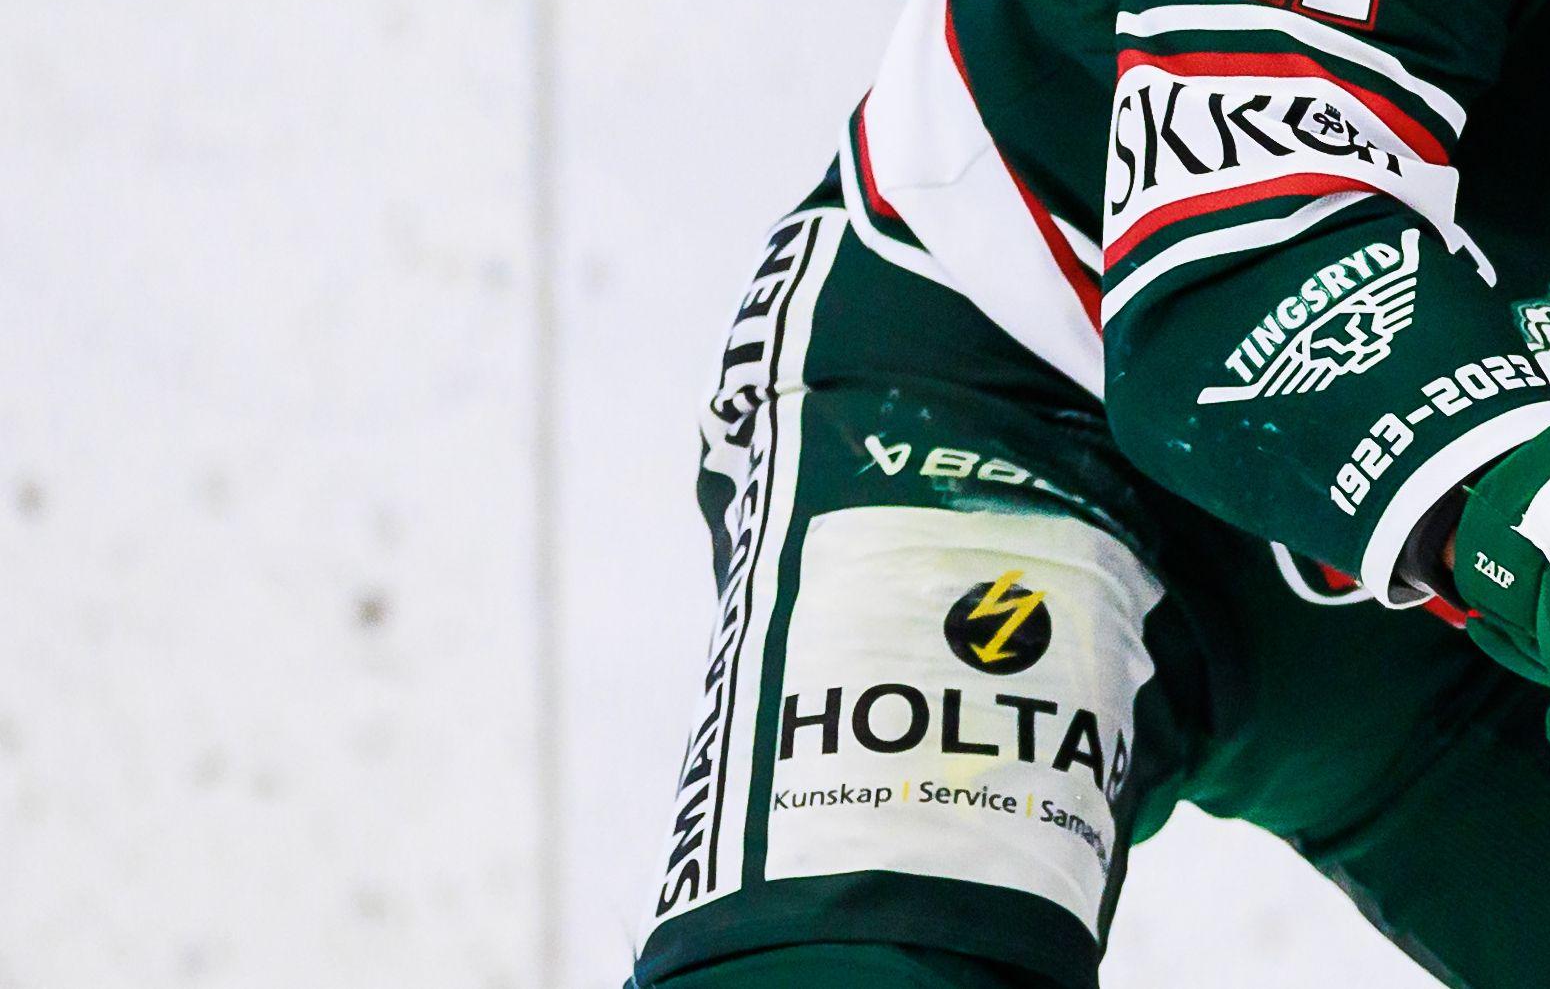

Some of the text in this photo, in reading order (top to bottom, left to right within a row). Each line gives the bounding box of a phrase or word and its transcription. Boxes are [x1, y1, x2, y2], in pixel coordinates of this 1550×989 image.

[1224, 241, 1401, 383] TINGSRYD
[1329, 354, 1546, 516] 1923-2023
[1474, 552, 1515, 589] TAIF
[774, 783, 892, 811] Kunskap
[919, 781, 1017, 813] Service
